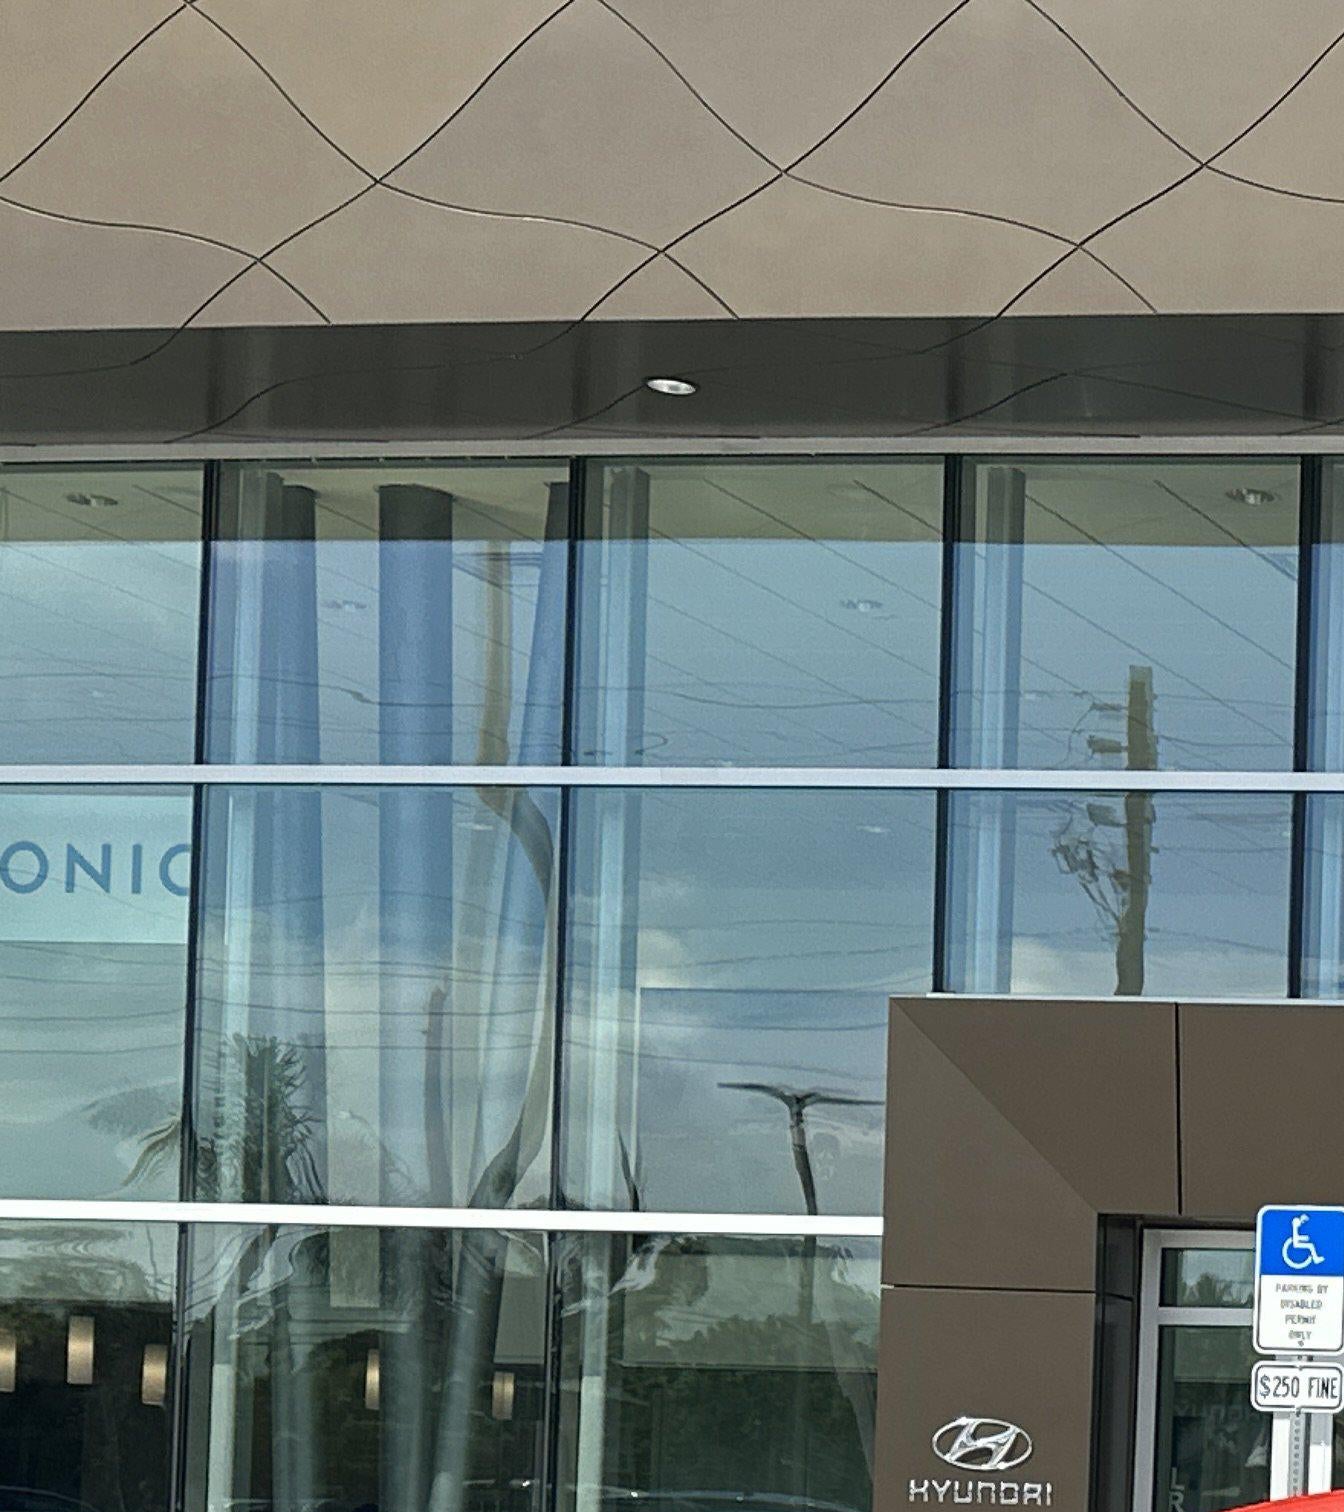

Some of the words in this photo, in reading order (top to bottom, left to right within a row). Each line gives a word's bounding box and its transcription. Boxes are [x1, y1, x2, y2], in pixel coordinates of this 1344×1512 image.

[1259, 1374, 1300, 1398] $250
[1308, 1376, 1338, 1399] FINE
[909, 1479, 1052, 1506] HYUNDAI
